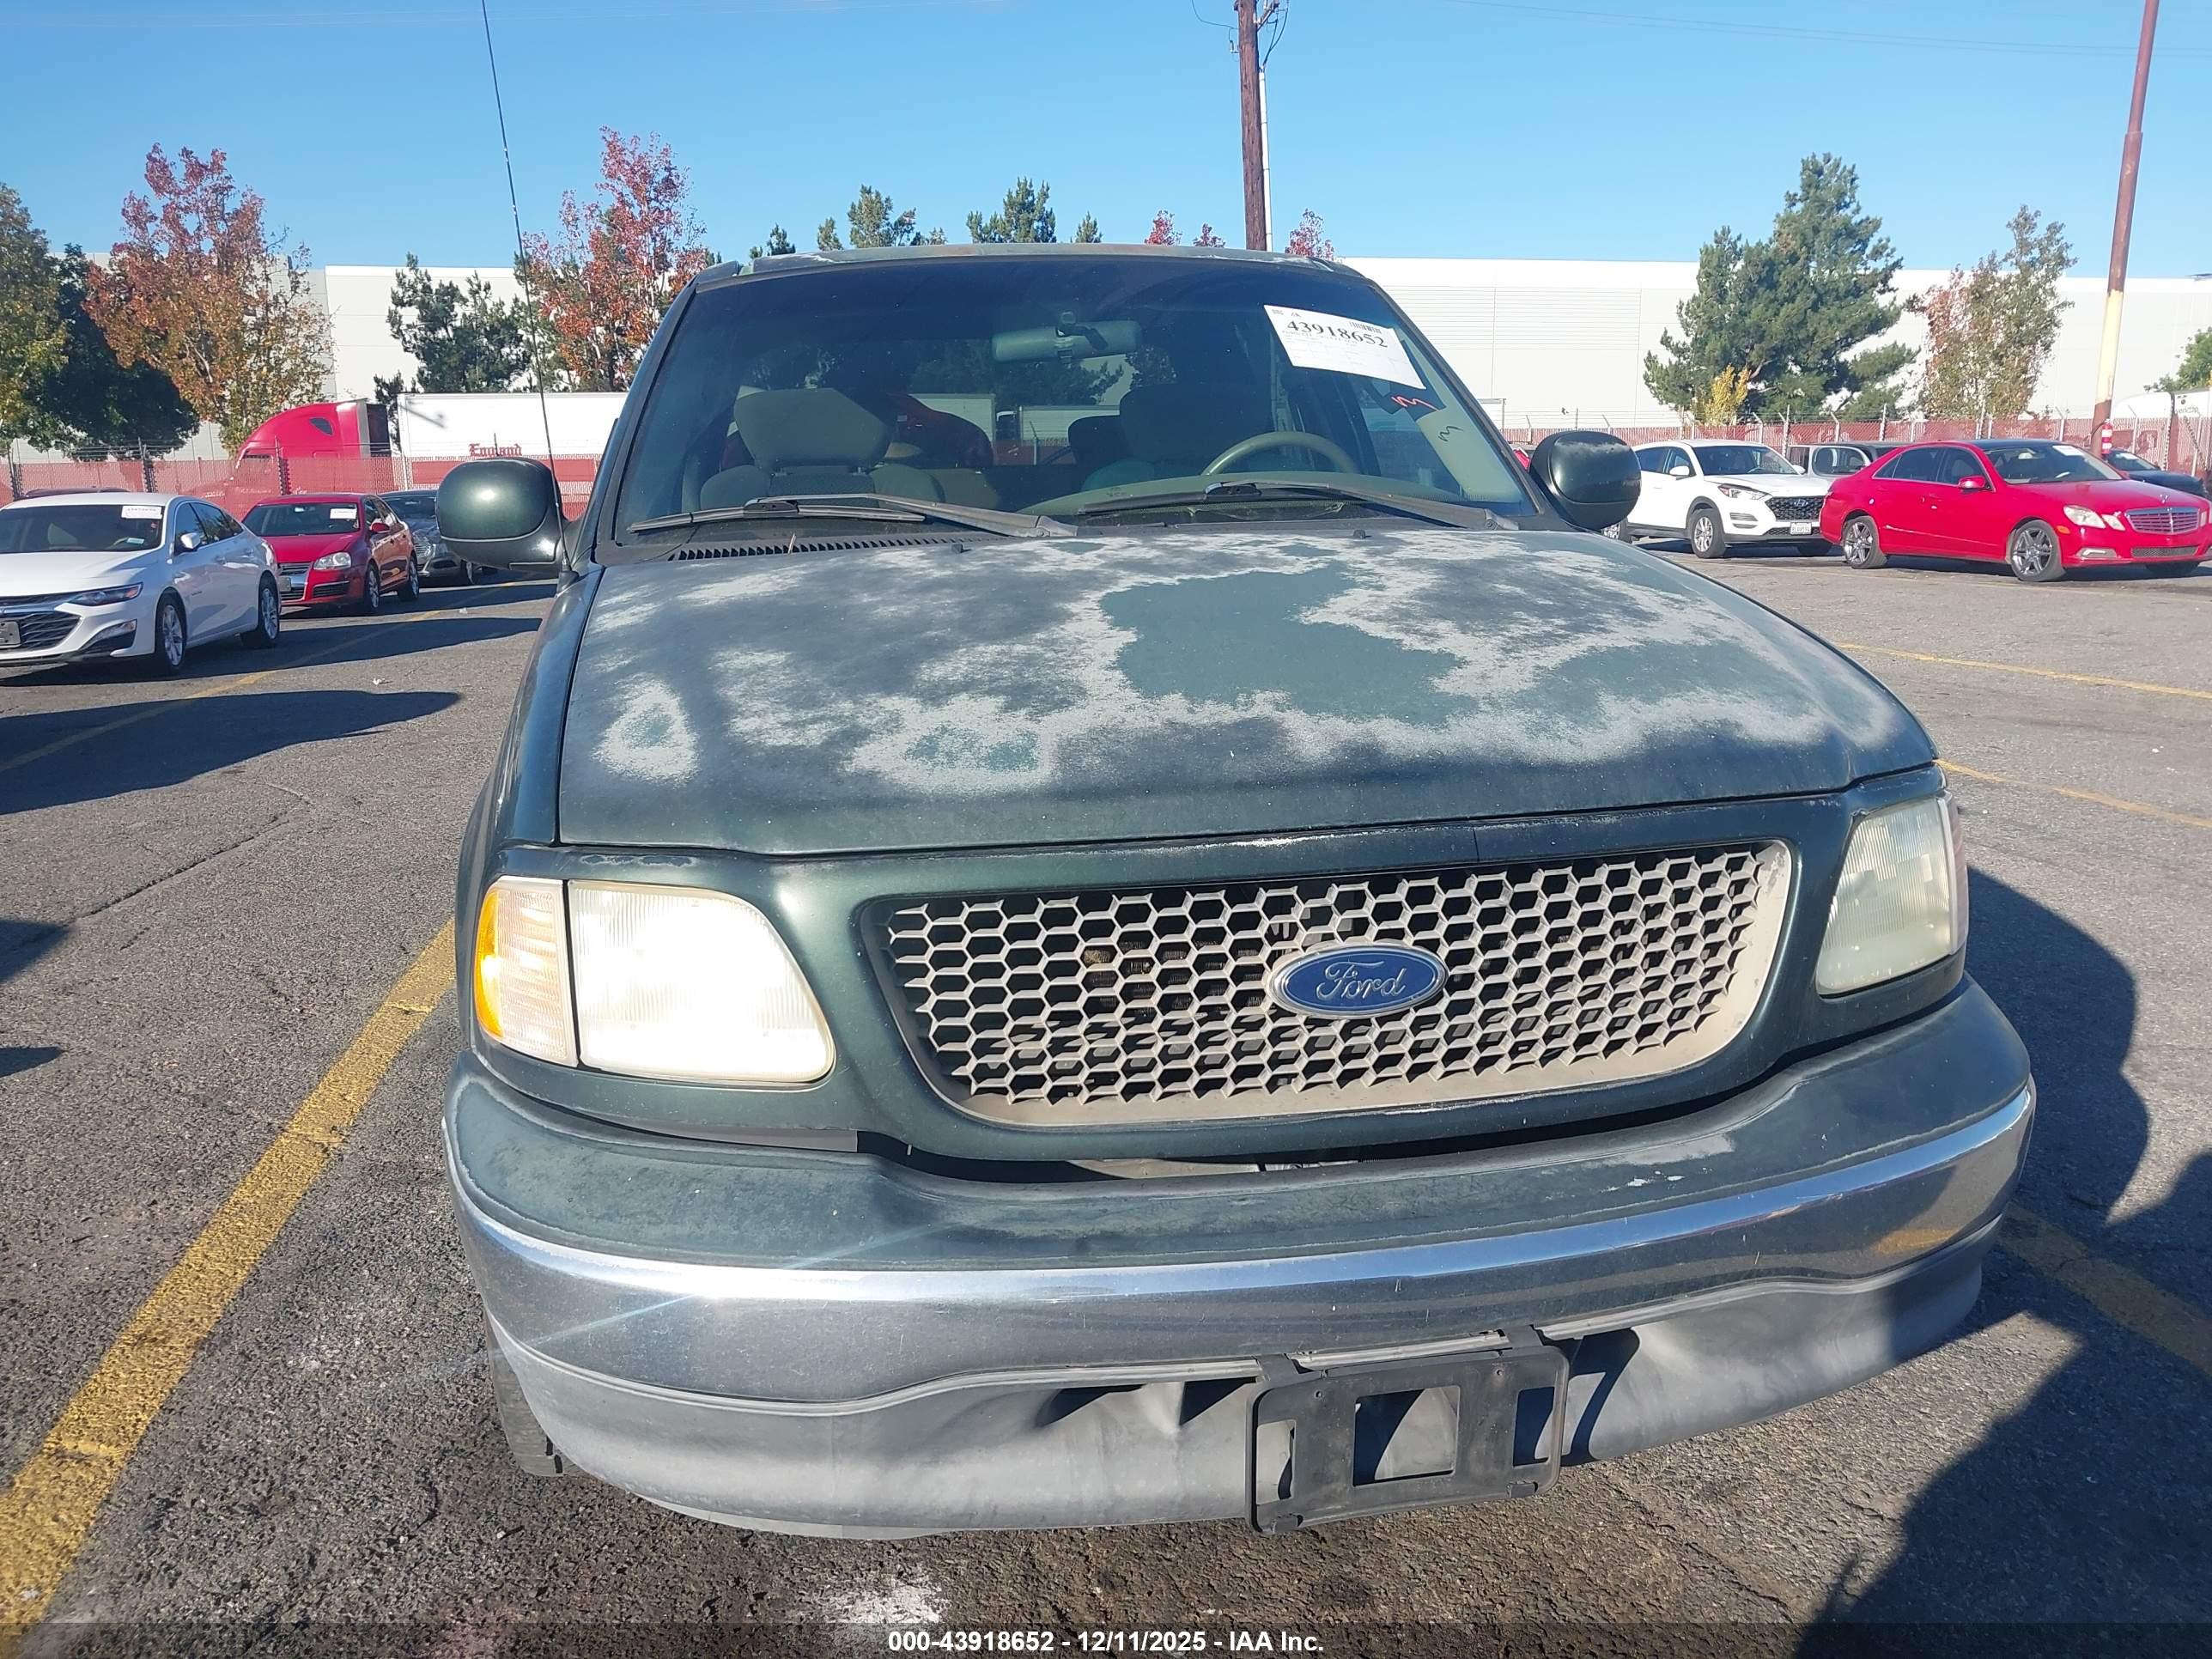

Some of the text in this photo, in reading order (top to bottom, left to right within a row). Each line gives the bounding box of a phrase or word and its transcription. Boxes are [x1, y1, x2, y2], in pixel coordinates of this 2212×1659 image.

[1287, 320, 1389, 348] 43918652
[468, 442, 523, 458] Engand
[1316, 960, 1407, 1000] Ford
